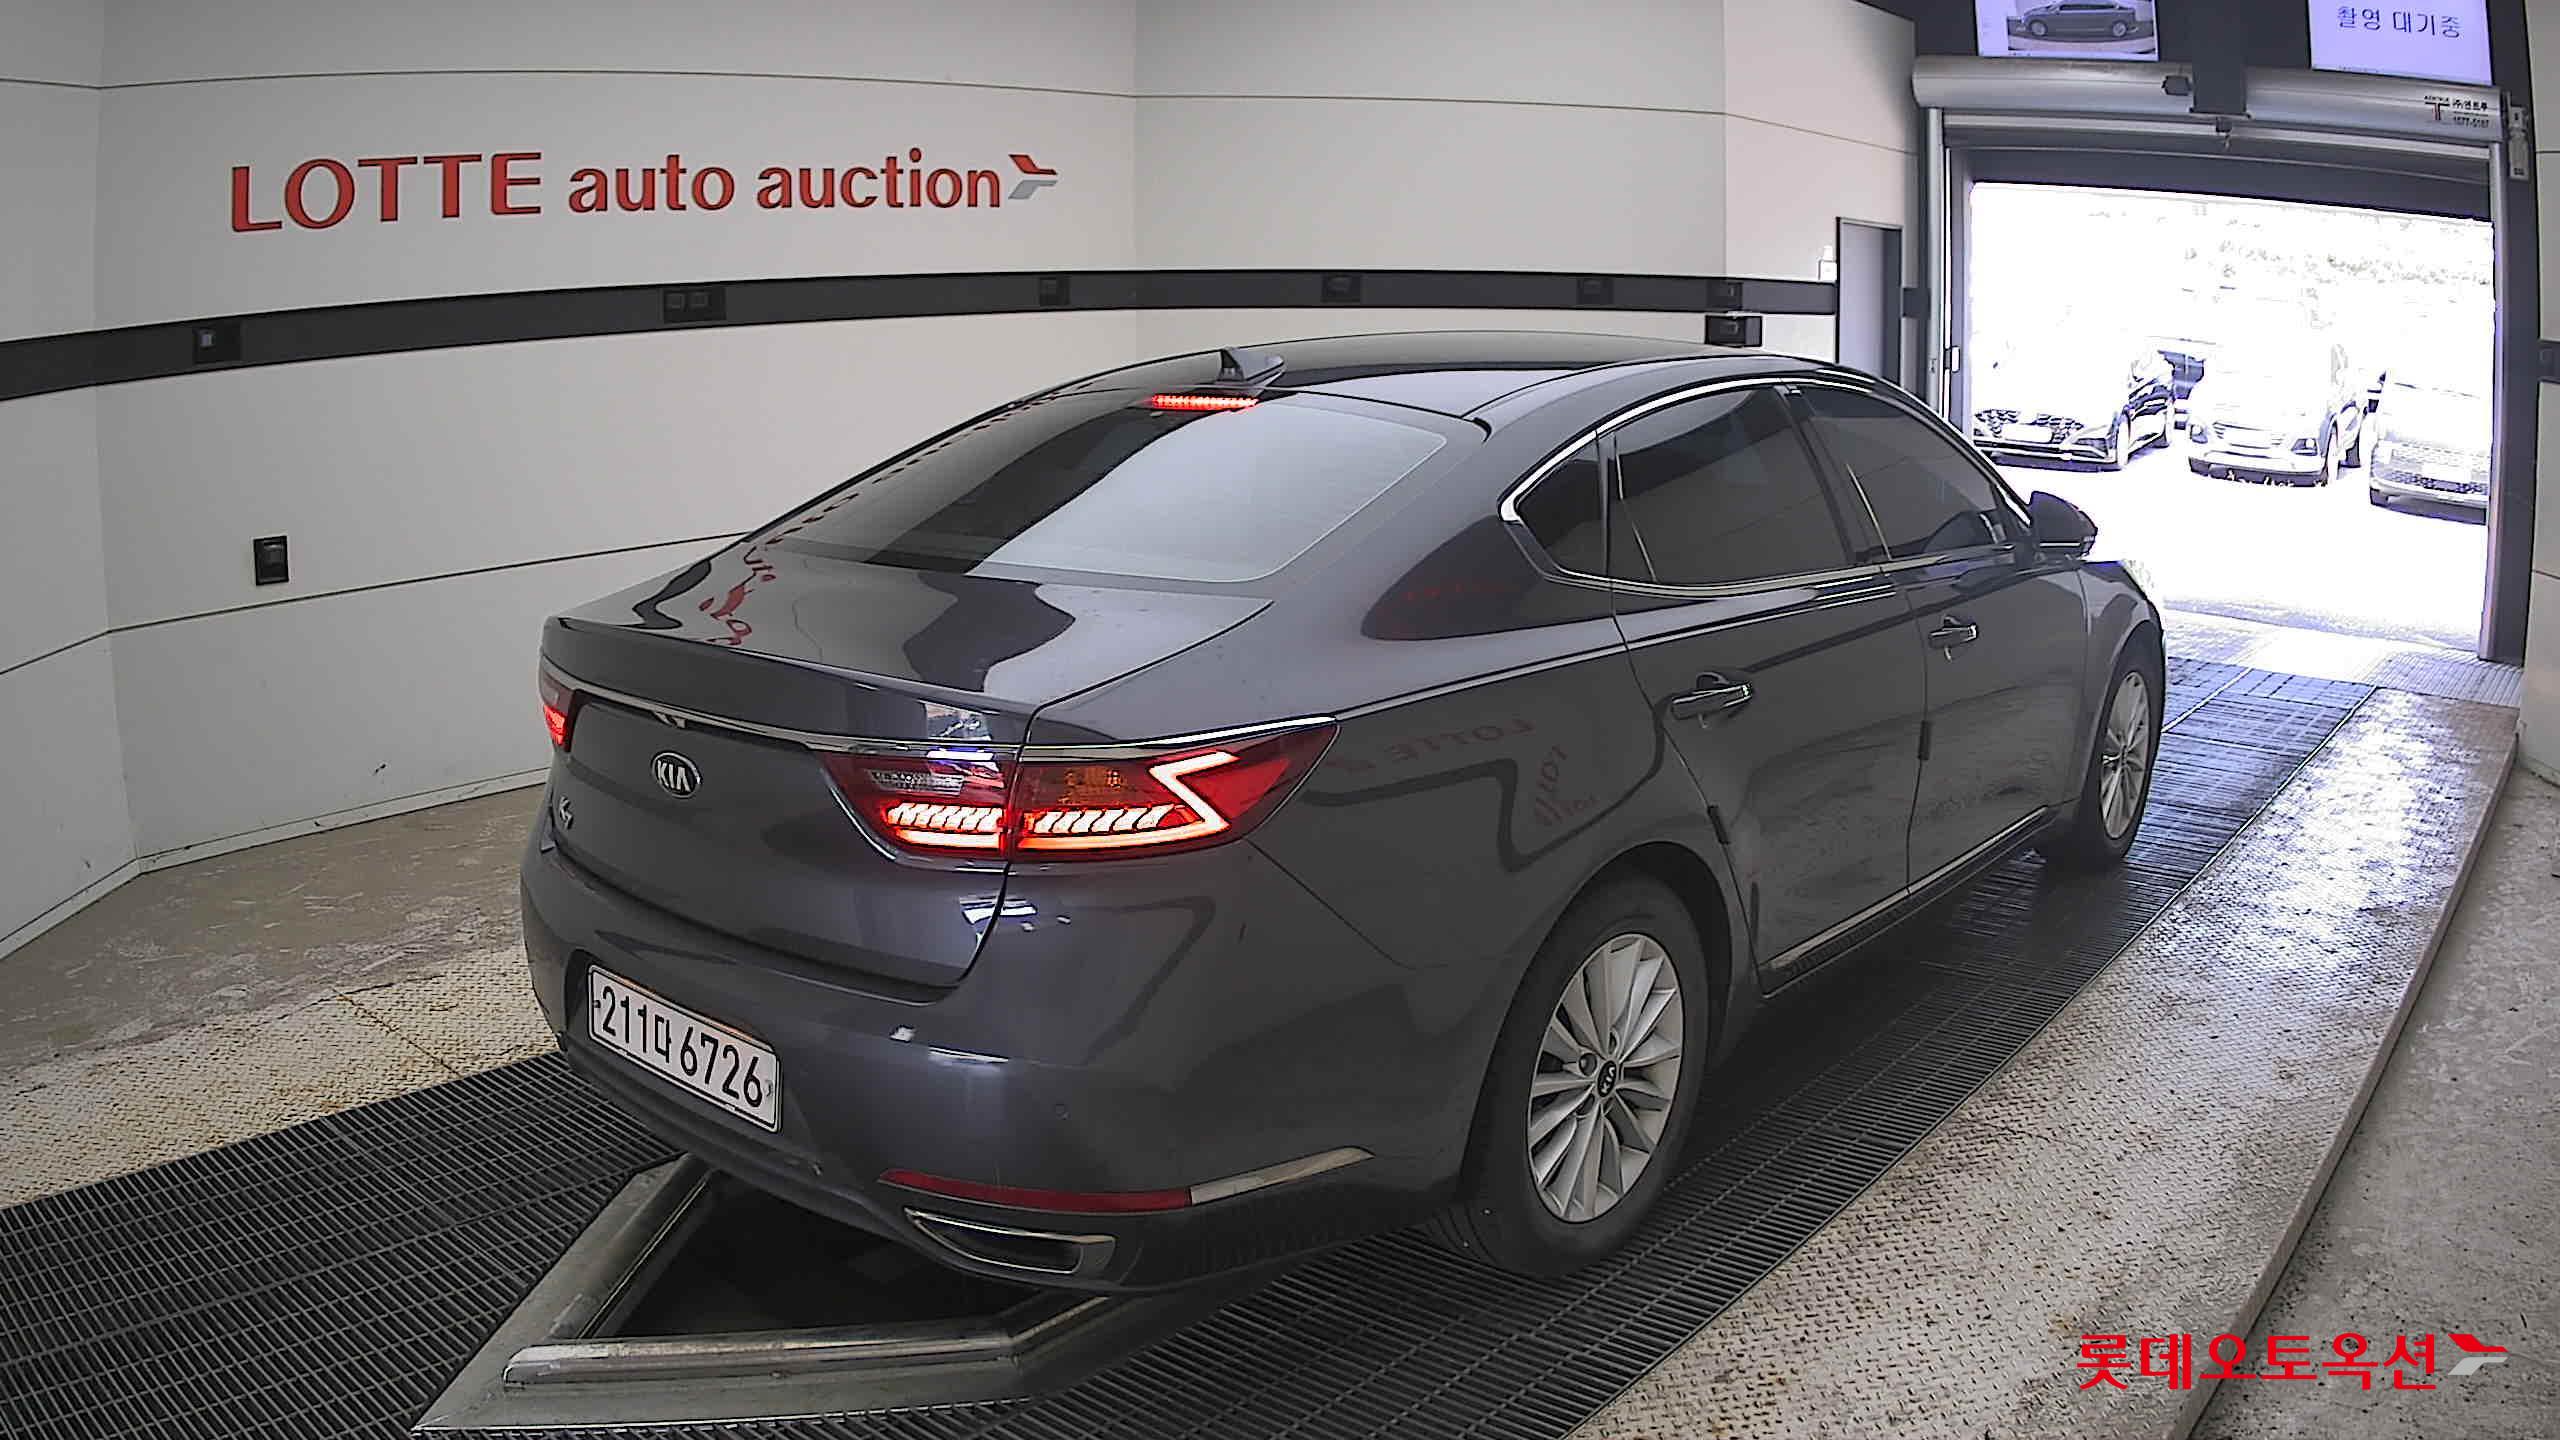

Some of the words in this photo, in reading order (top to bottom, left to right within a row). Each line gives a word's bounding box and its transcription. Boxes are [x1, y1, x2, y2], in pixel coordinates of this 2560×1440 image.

[2338, 6, 2381, 31] 촬영
[2392, 11, 2460, 38] 대기중
[231, 152, 541, 233] LOTTE
[568, 154, 735, 214] auto
[756, 147, 1001, 210] auction
[657, 760, 691, 792] KIA
